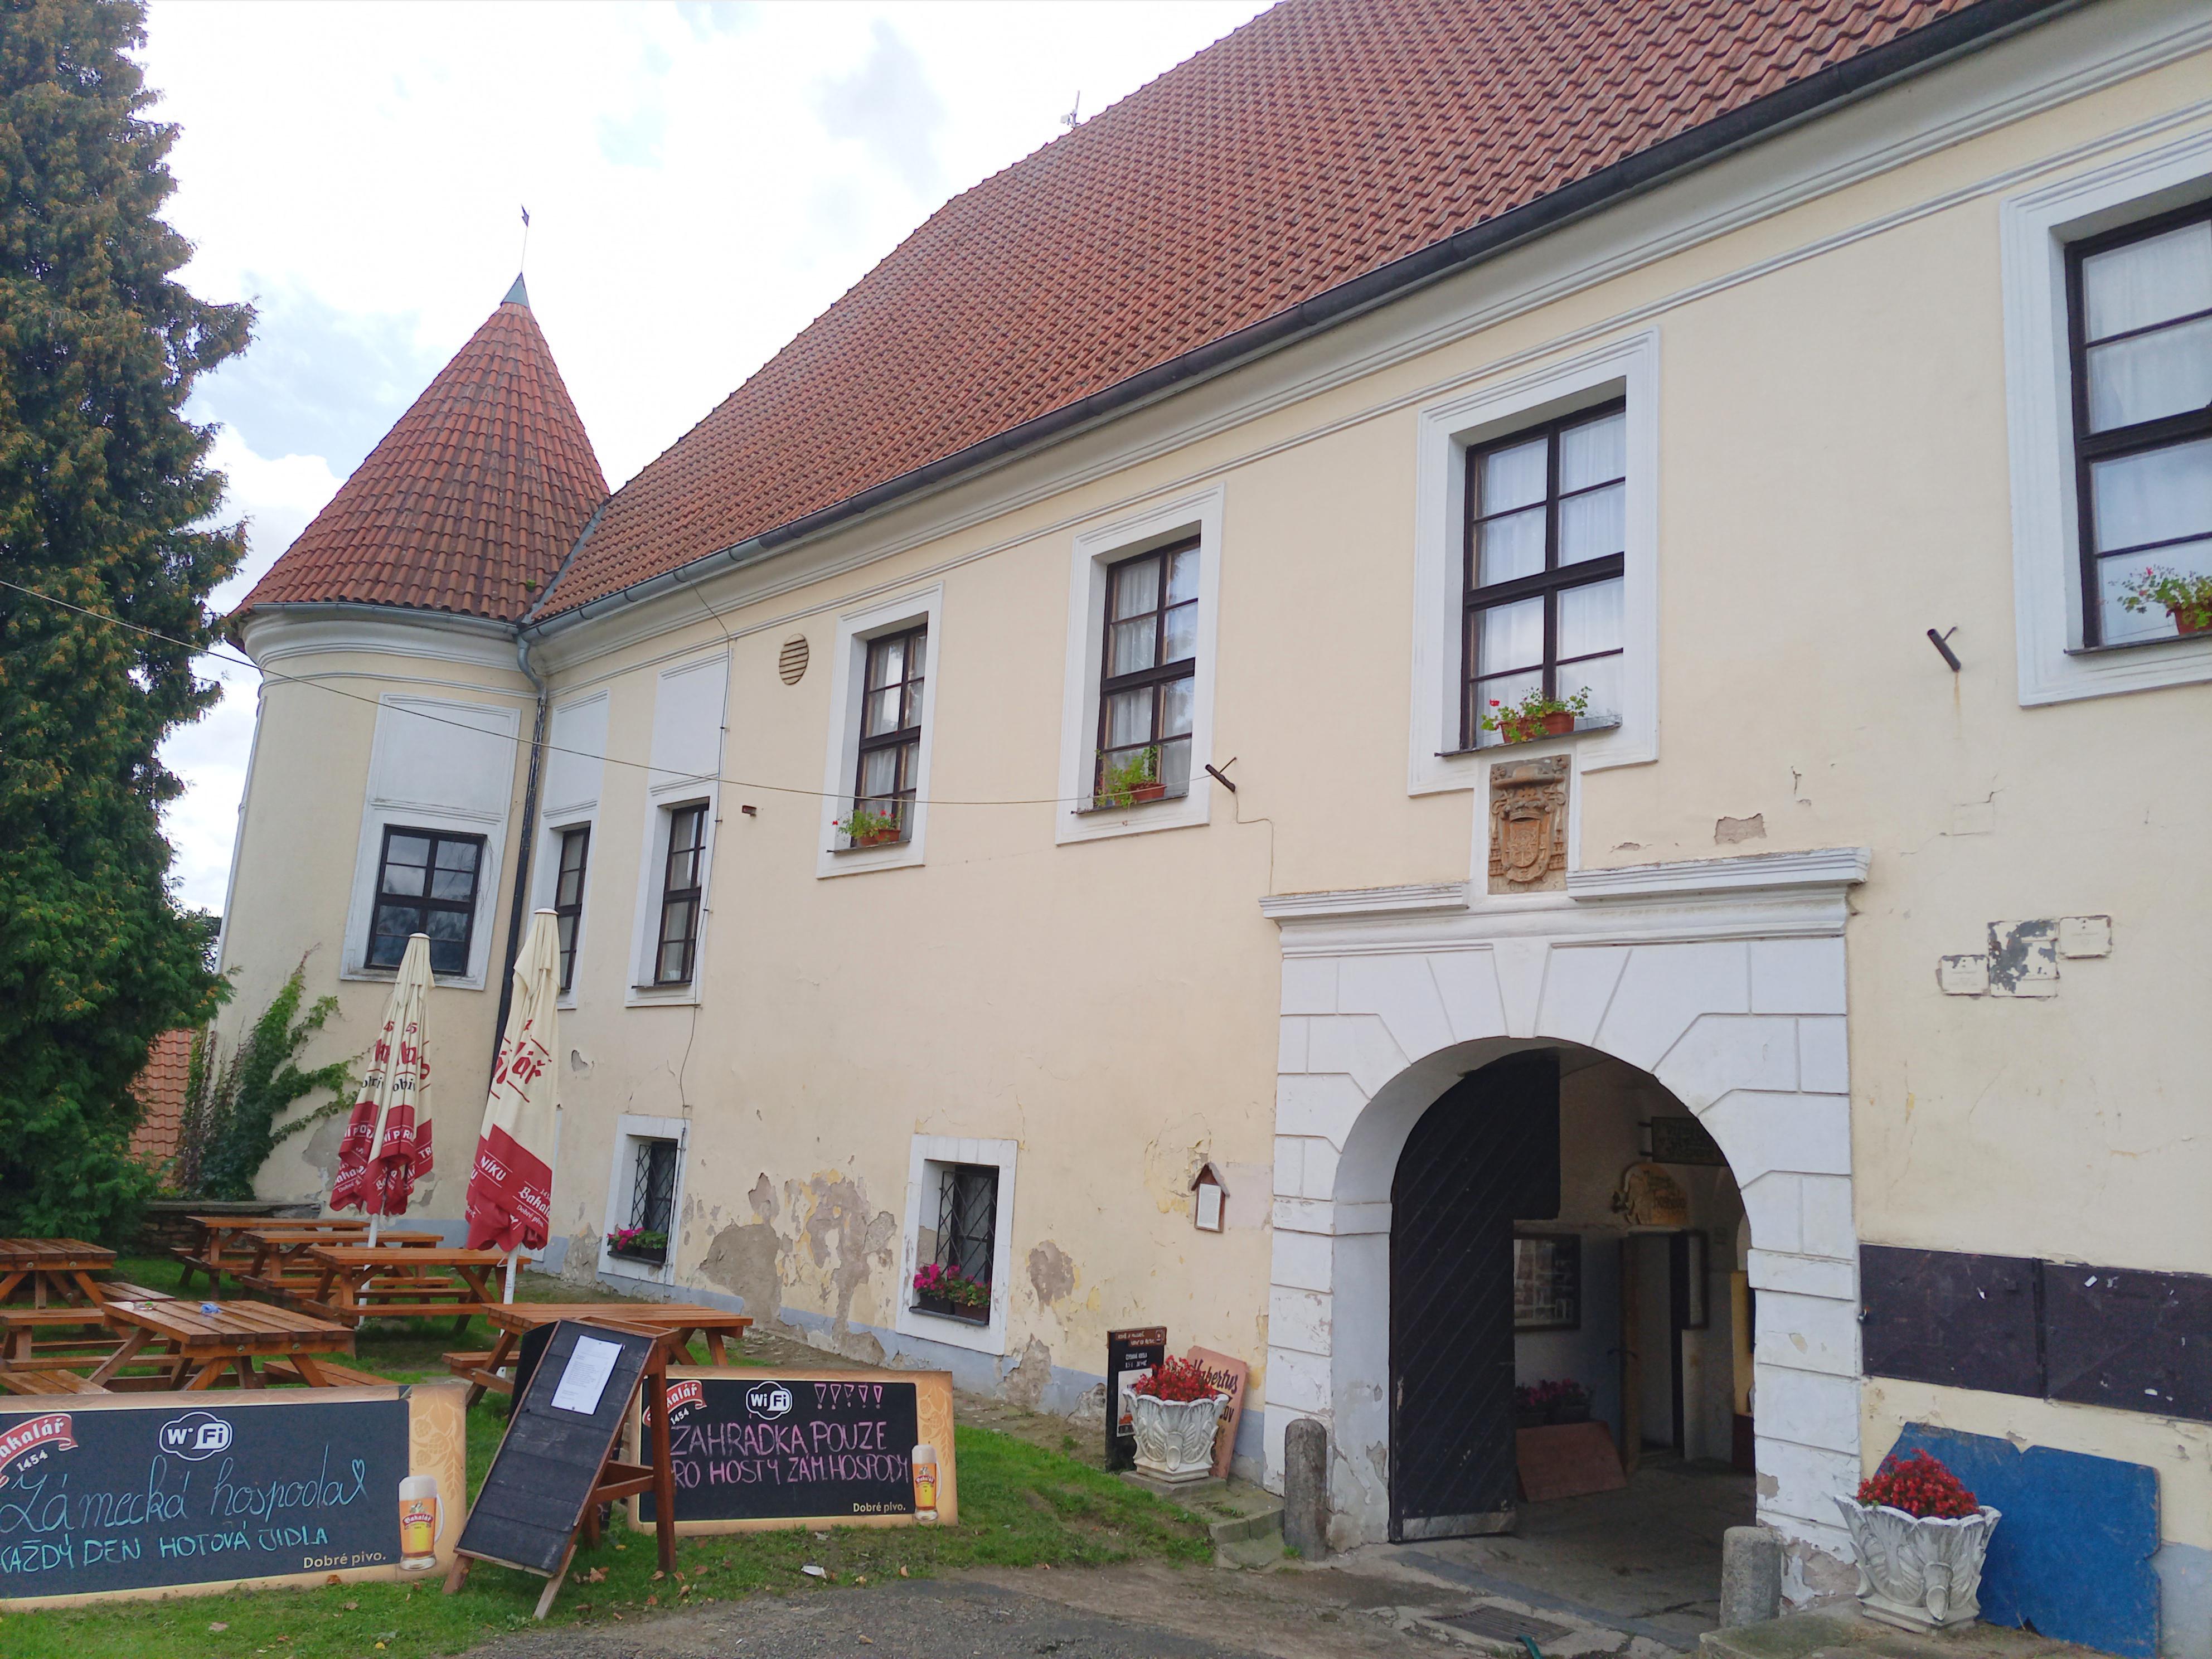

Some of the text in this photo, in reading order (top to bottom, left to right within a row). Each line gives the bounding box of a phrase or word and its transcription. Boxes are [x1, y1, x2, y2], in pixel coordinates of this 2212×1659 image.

[750, 1394, 787, 1408] WiFi
[670, 1408, 690, 1425] 1454
[0, 1417, 65, 1460] akalář
[809, 1421, 887, 1454] POUZE
[16, 1449, 48, 1472] 1454
[671, 1459, 701, 1488] RO
[710, 1458, 780, 1485] HOSTY
[829, 1453, 909, 1483] HOSPODY
[210, 1441, 358, 1523] hospoda
[853, 1500, 906, 1514] Dobré pivo.
[84, 1537, 140, 1566] DEN
[159, 1520, 251, 1559] HOTOVÁ
[303, 1550, 386, 1569] Dobré pivo.
